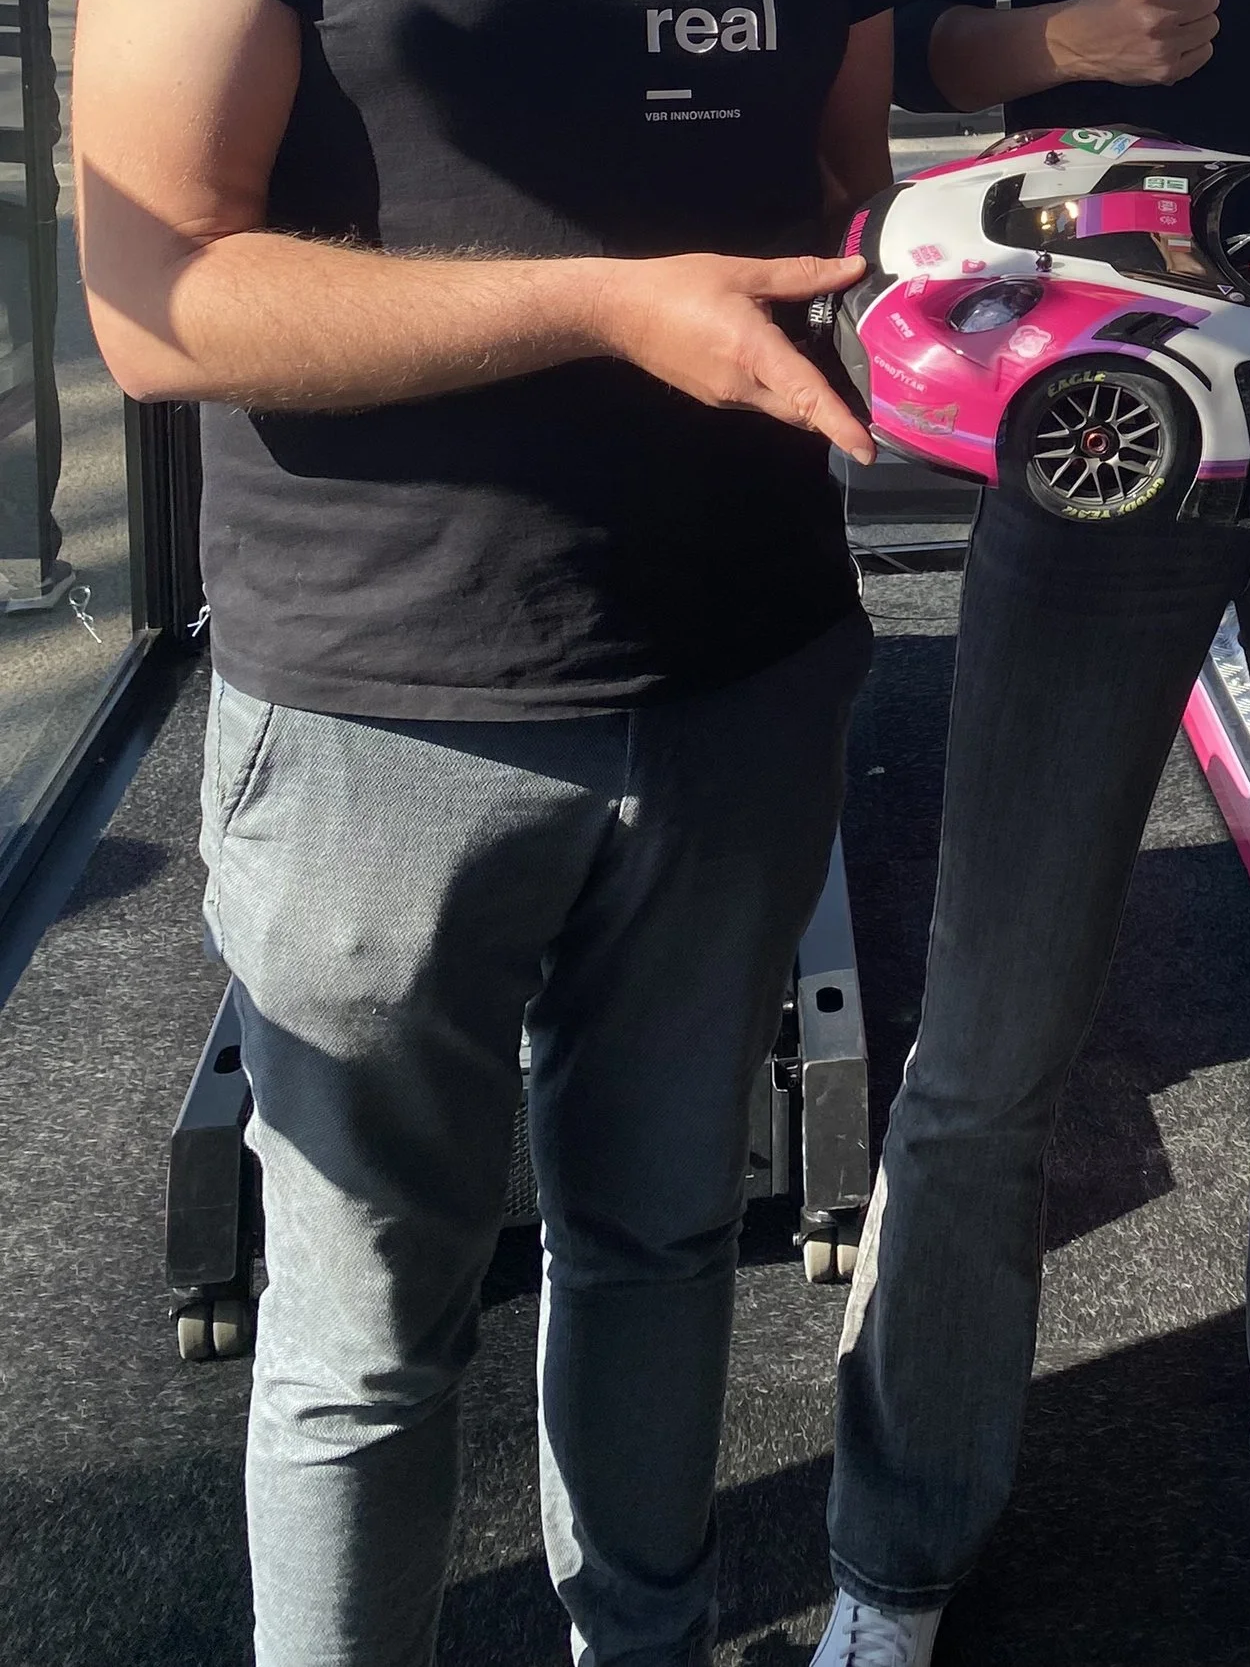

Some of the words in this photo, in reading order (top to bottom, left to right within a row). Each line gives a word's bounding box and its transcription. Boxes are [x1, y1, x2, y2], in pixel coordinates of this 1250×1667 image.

[645, 111, 668, 122] VBR
[670, 108, 741, 121] INNOVATIONS
[873, 355, 926, 392] GOODYEAR
[1047, 370, 1107, 397] EAGLE
